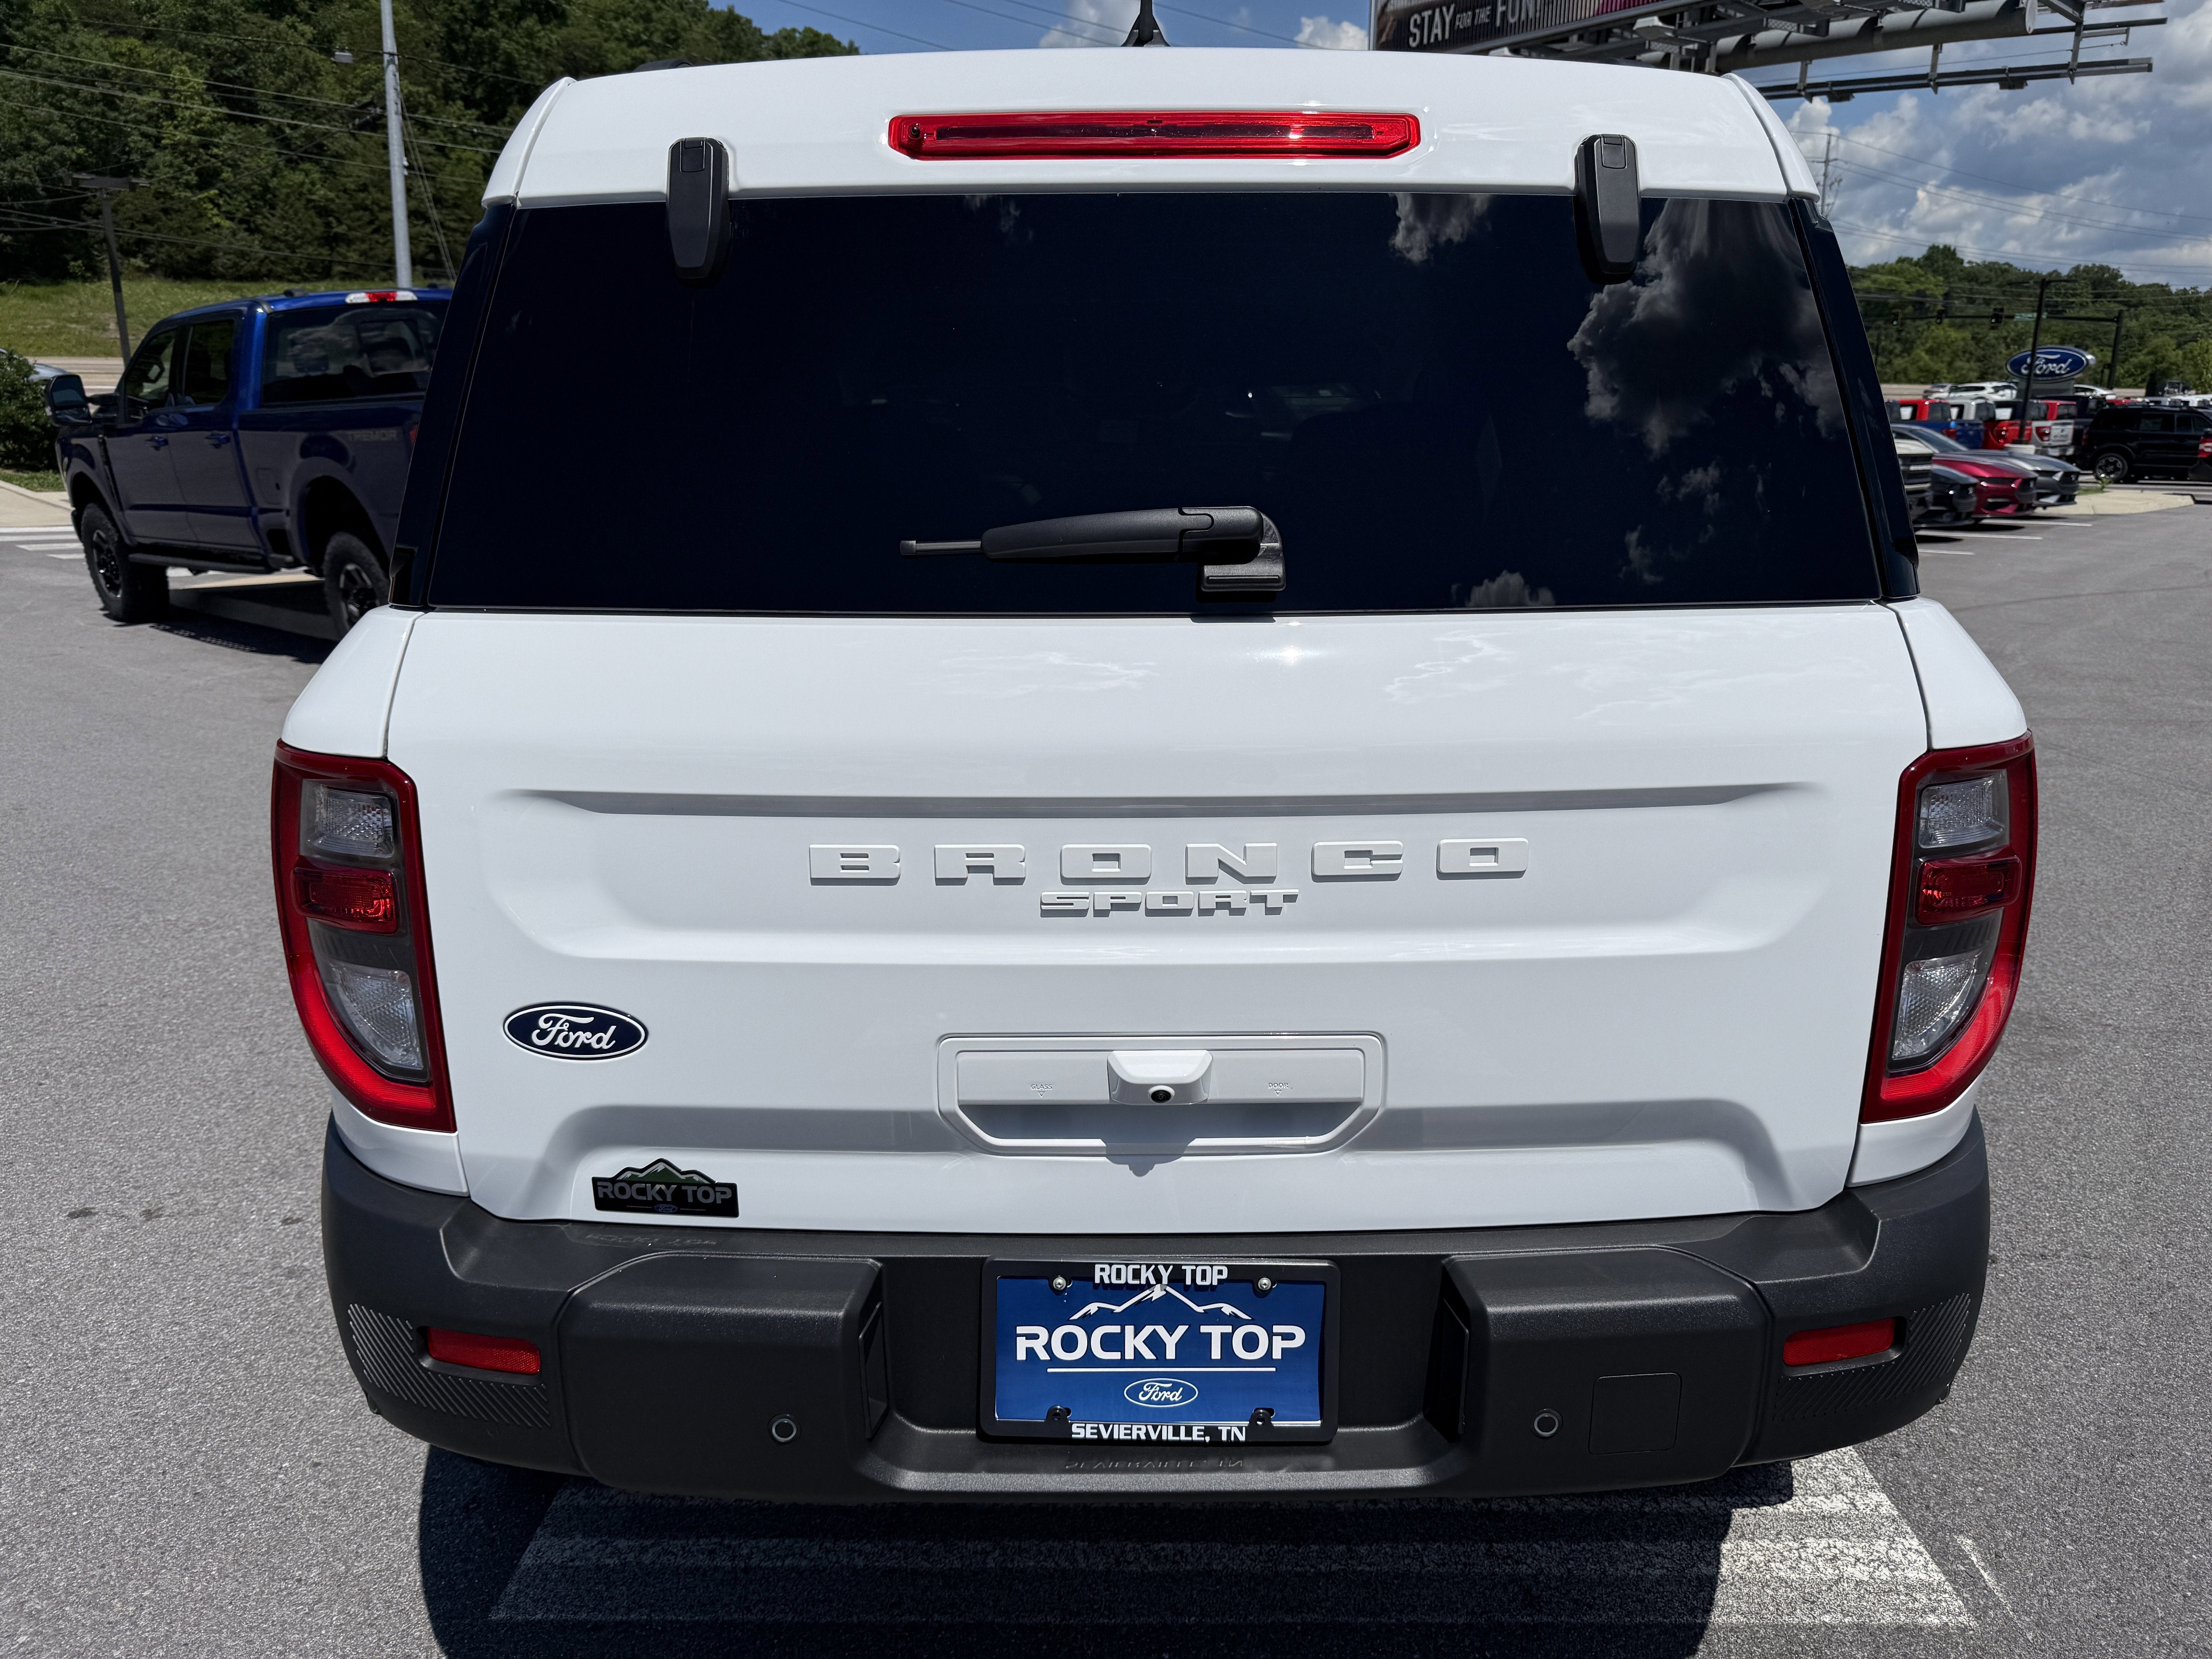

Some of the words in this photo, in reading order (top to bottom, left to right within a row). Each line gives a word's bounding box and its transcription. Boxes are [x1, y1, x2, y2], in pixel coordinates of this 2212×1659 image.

[1409, 4, 1455, 48] STAY
[1455, 12, 1472, 29] FOR
[1474, 6, 1492, 26] THE
[2021, 354, 2072, 374] Ford
[809, 838, 1529, 886] BRONCO
[1040, 889, 1299, 917] SPORT
[532, 1013, 617, 1049] Ford
[597, 1181, 677, 1201] ROCKY
[682, 1186, 732, 1204] TOP
[1095, 1264, 1173, 1285] ROCKY
[1182, 1266, 1228, 1285] TOP
[1016, 1325, 1189, 1360] ROCKY
[1200, 1325, 1305, 1360] TOP
[1139, 1382, 1182, 1401] Ford
[1072, 1424, 1210, 1442] SEVIERVILLE,
[1218, 1426, 1246, 1442] TN
